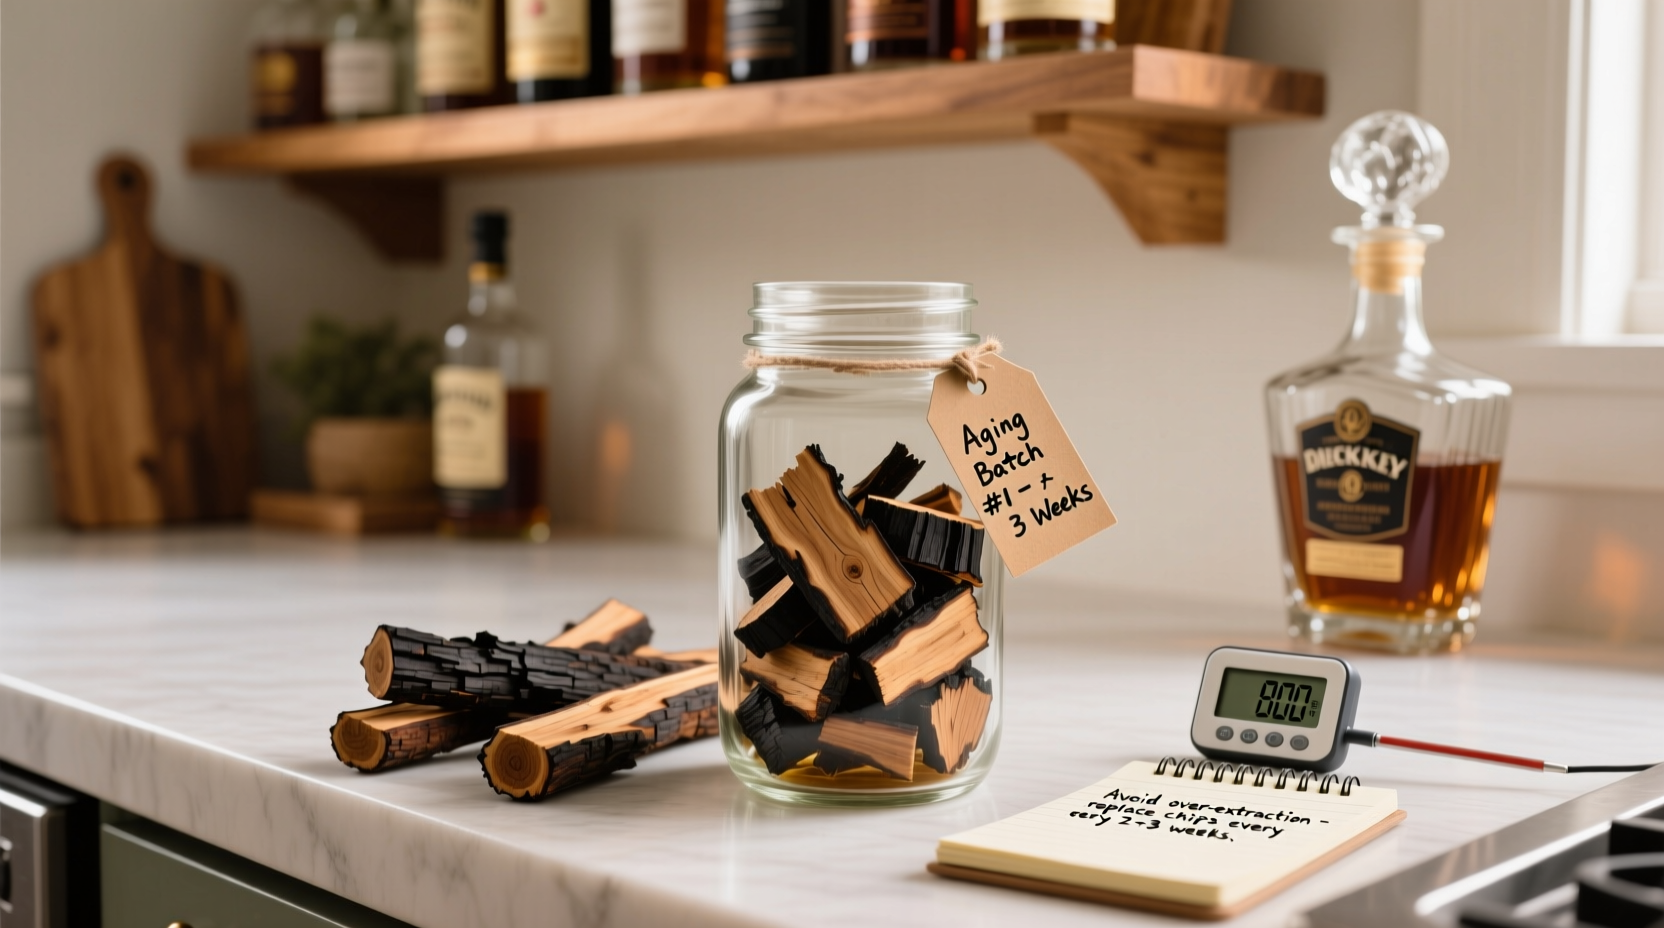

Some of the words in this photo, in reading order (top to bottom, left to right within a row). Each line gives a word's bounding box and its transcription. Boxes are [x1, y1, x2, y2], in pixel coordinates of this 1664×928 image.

[962, 412, 1030, 456] Aging
[973, 443, 1044, 487] Batch
[982, 487, 1014, 516] #1
[1009, 514, 1027, 538] 3
[1030, 484, 1094, 526] Weeks
[1255, 680, 1312, 722] 800
[1103, 788, 1162, 805] Avoid
[1168, 800, 1311, 825] over-extraction
[1164, 811, 1217, 825] chips
[1228, 821, 1284, 839] every
[1169, 825, 1234, 842] weeks.
